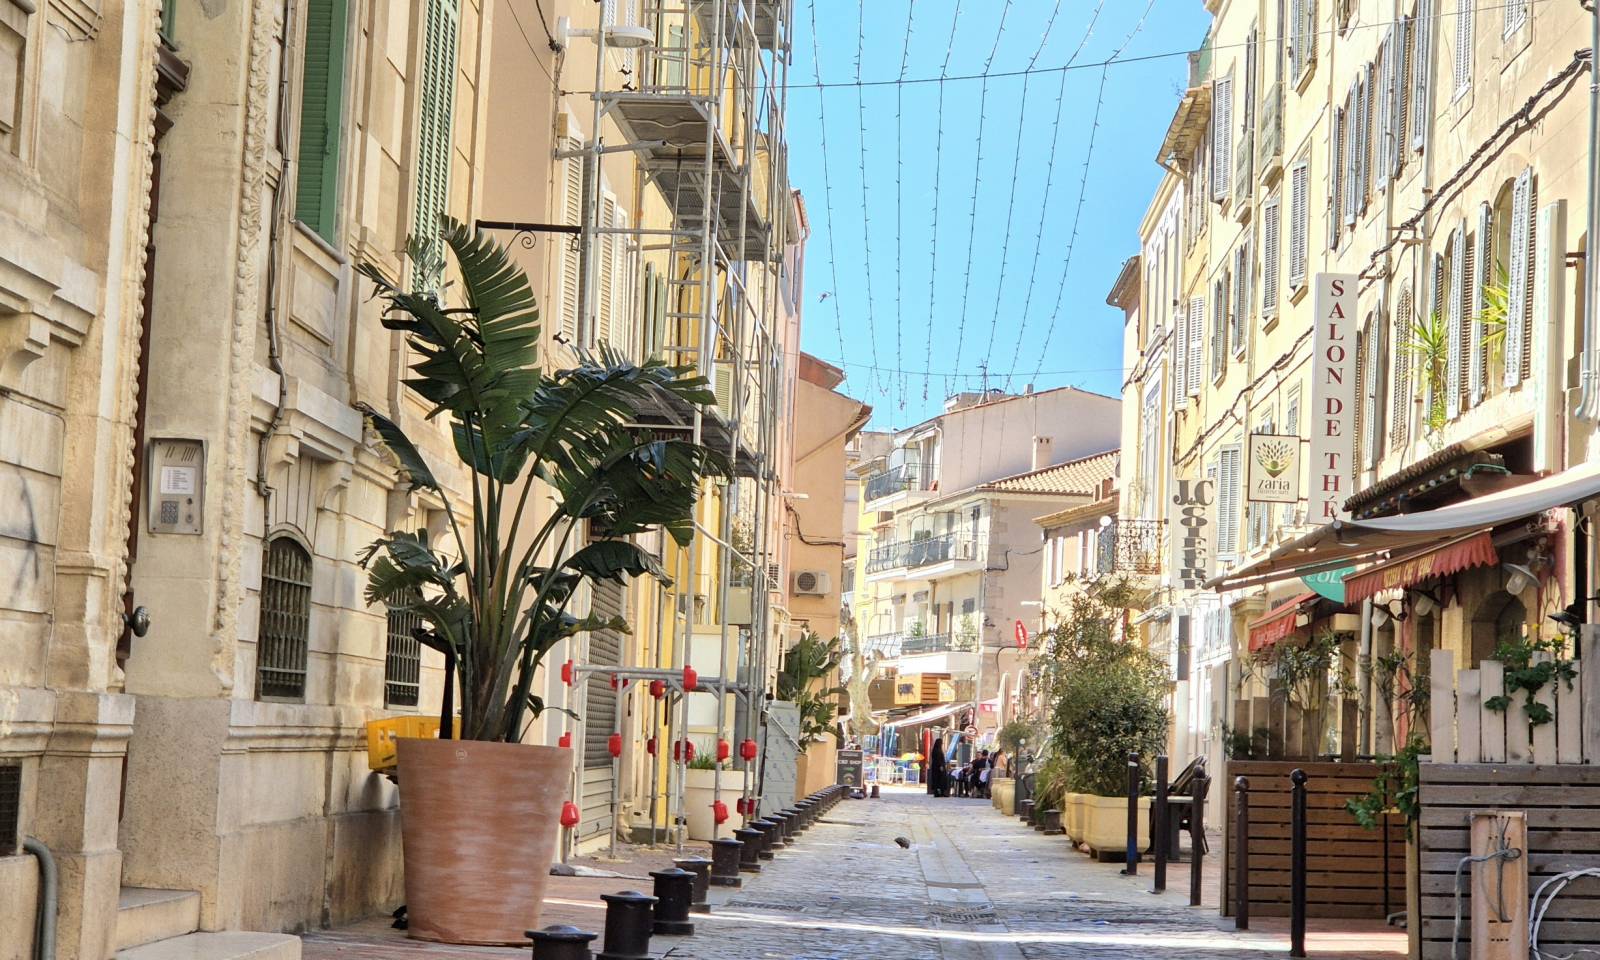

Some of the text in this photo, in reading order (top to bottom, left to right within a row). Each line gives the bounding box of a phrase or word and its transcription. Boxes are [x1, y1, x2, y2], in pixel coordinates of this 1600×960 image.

[1322, 279, 1346, 518] SALON DE THÉ
[1257, 478, 1290, 491] zaria
